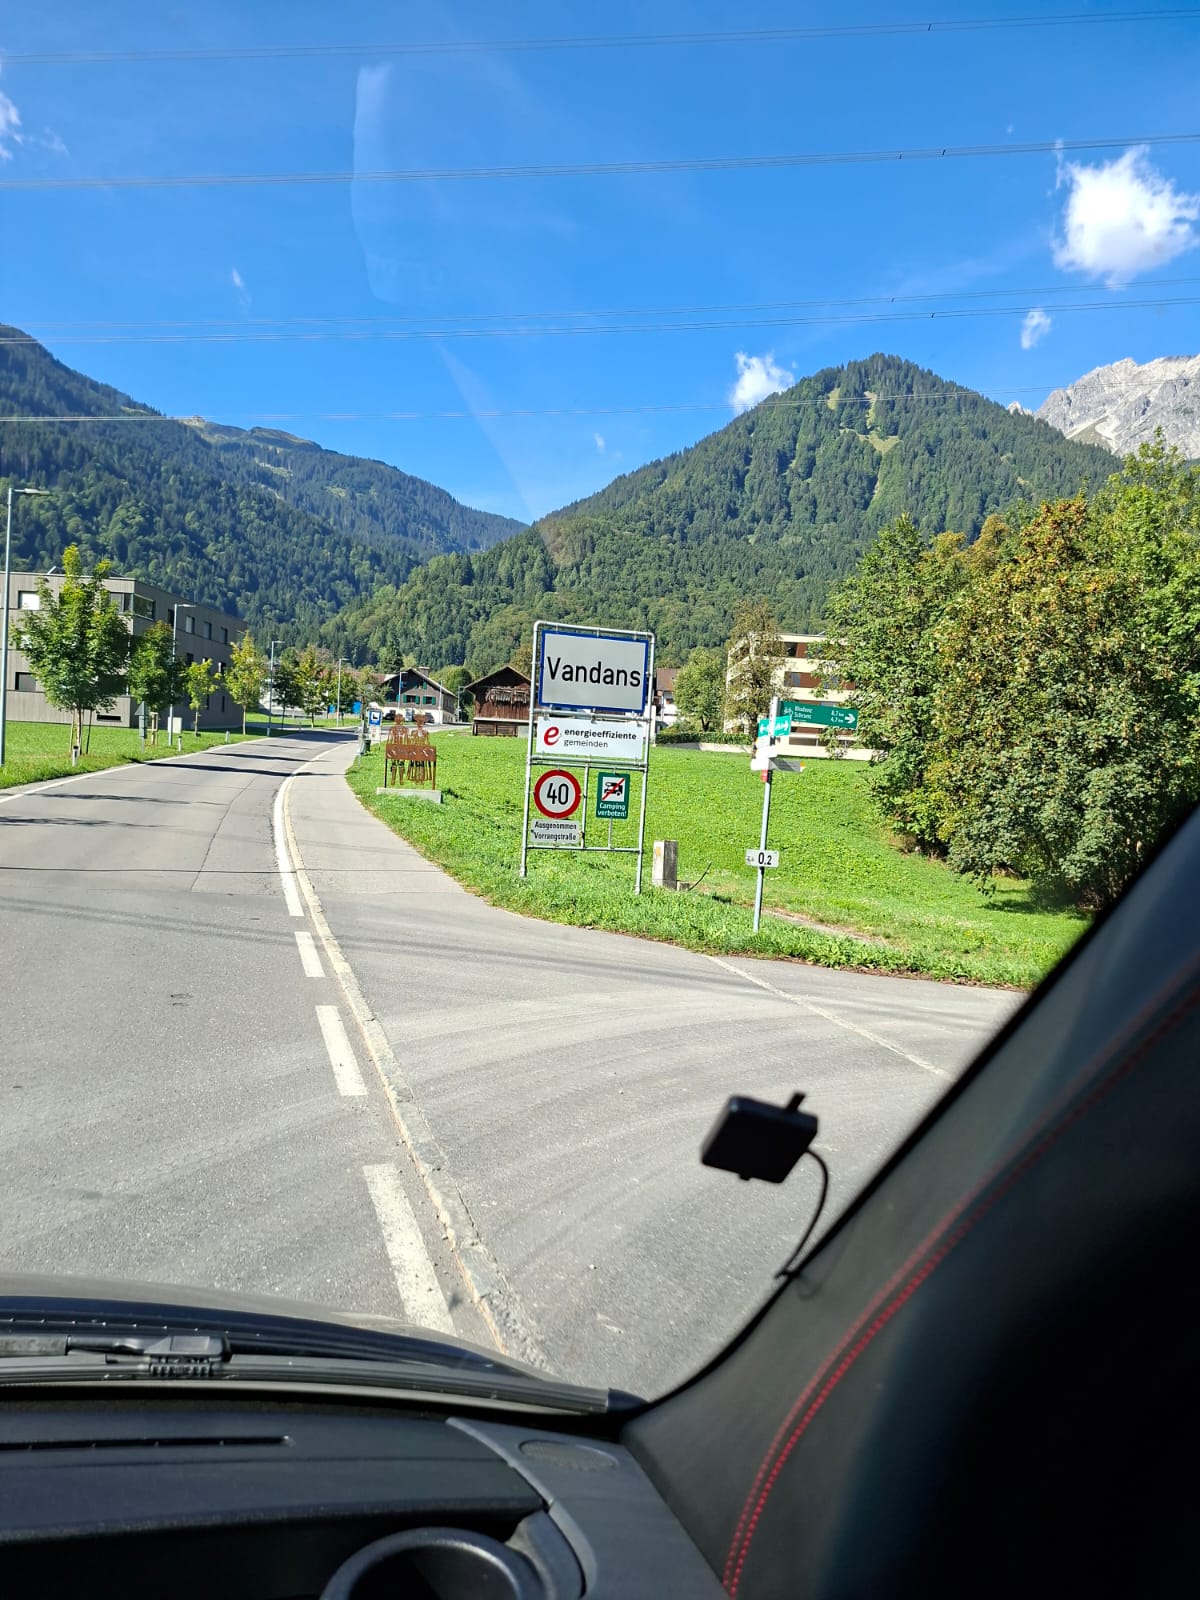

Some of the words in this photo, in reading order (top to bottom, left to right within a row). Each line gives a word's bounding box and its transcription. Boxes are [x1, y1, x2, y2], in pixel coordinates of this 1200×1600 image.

[546, 656, 641, 688] Vandans
[564, 728, 637, 741] energieeffiziente
[563, 739, 608, 748] gemeinden
[546, 782, 569, 805] 40
[599, 802, 626, 811] Camping
[534, 821, 577, 831] Ausgenommen
[533, 831, 577, 842] Vorrangstraße
